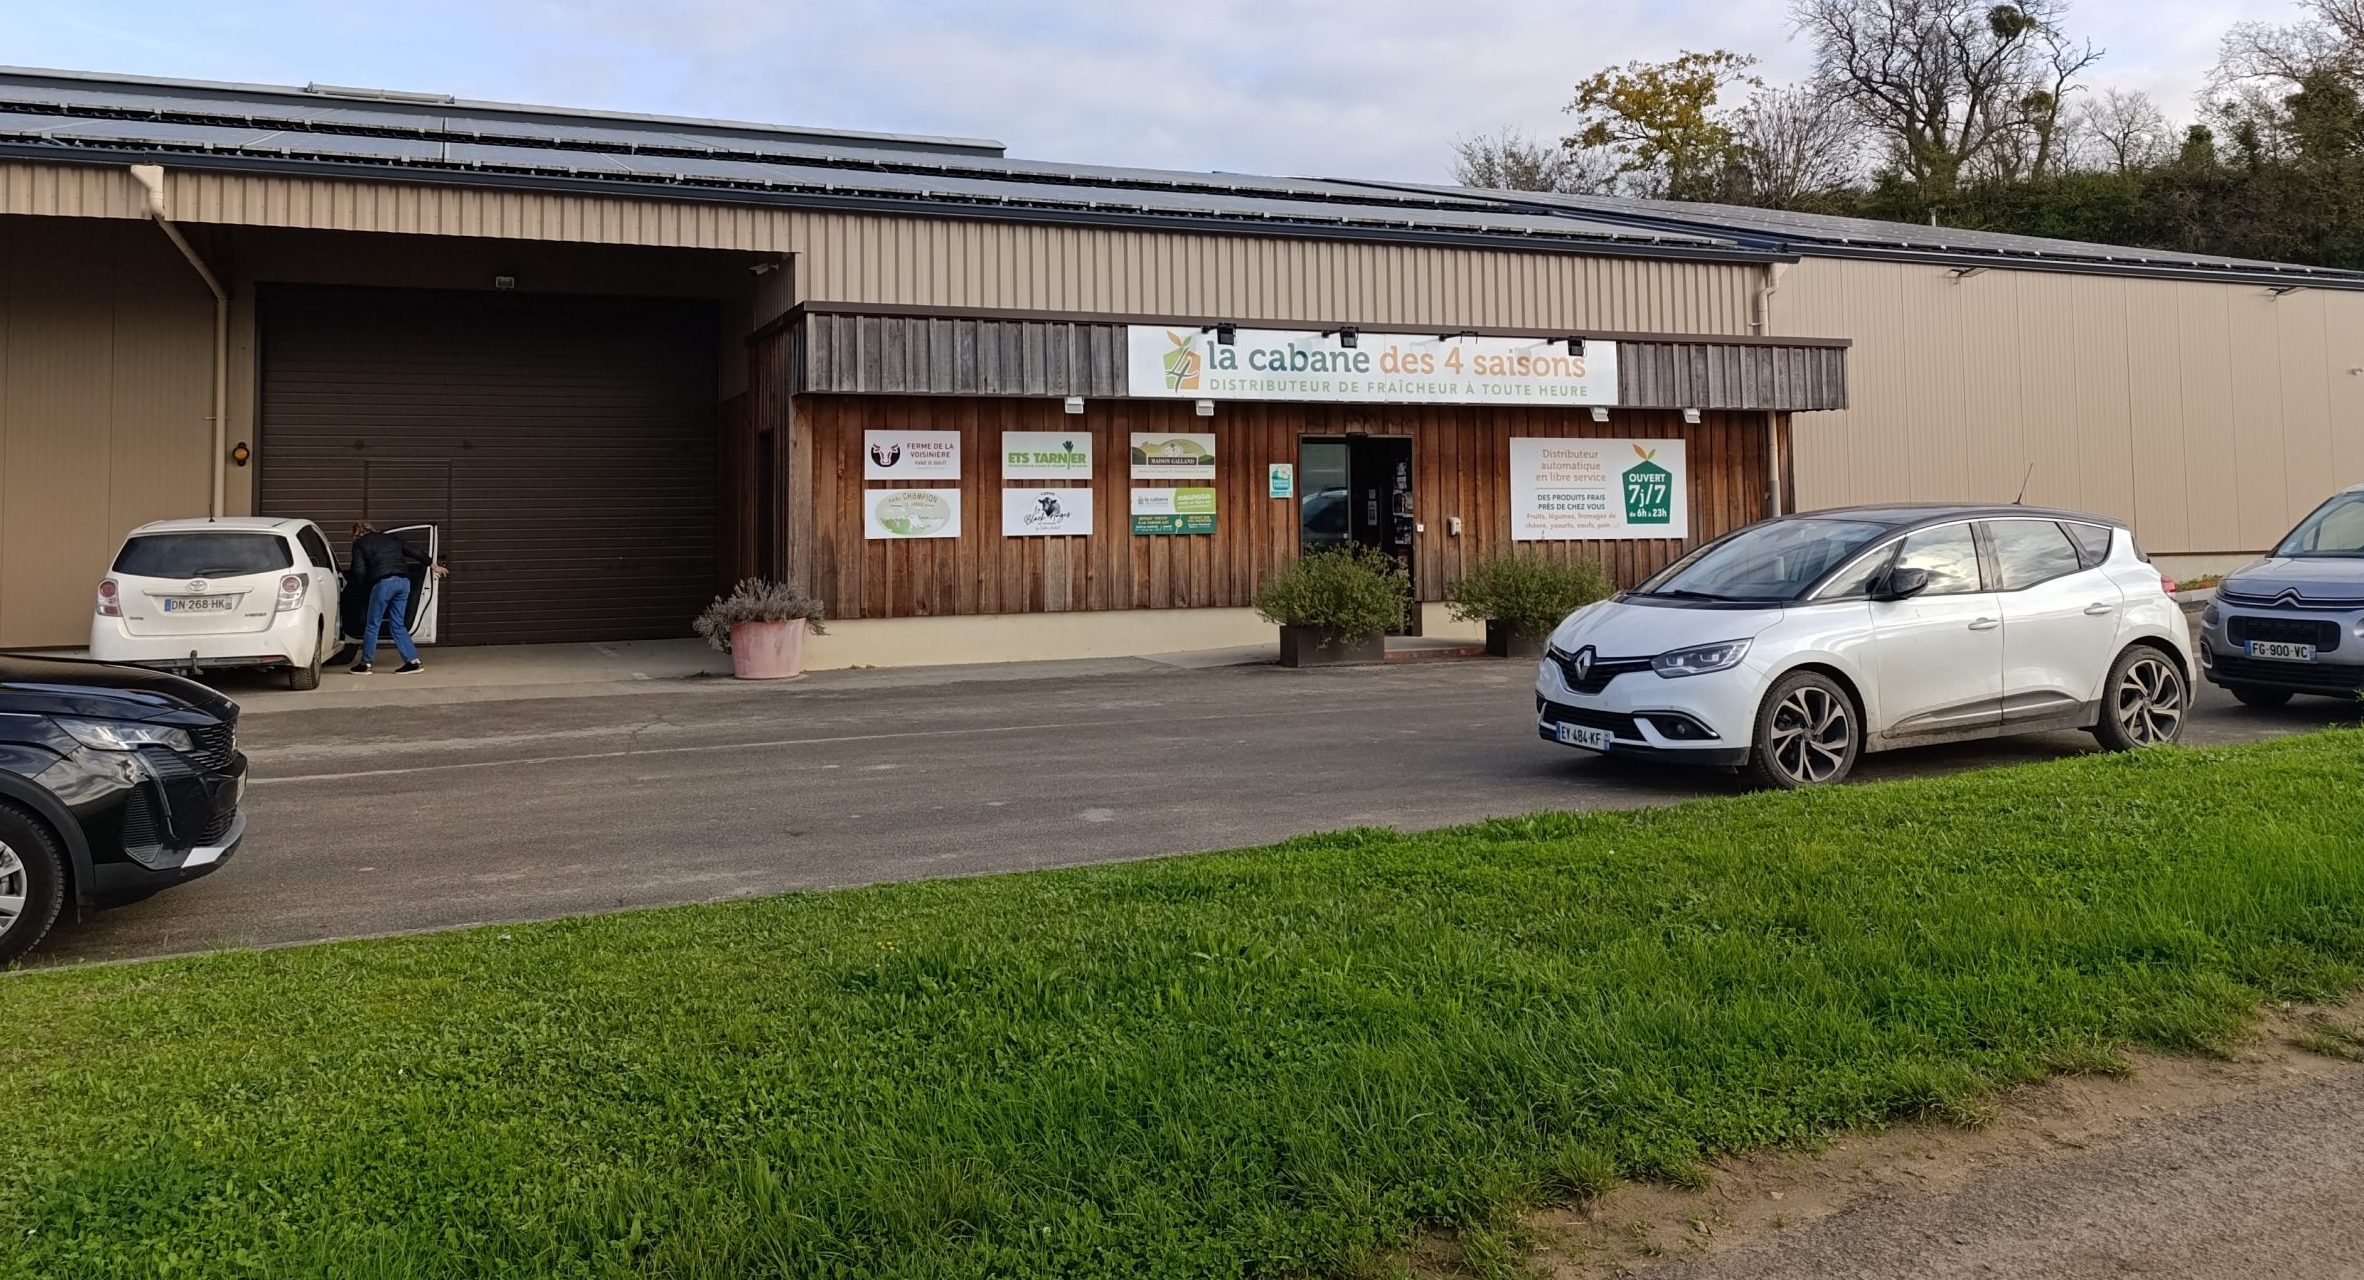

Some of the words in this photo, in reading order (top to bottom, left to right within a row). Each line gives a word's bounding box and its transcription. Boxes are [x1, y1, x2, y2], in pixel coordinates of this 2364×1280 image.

[1207, 340, 1238, 370] la
[1249, 342, 1370, 373] cabane
[1380, 345, 1435, 375] des
[1444, 346, 1464, 375] 4
[1473, 349, 1586, 378] saisons
[1210, 378, 1331, 393] DISTRIBUTEUR
[1339, 381, 1358, 393] DE
[1367, 379, 1457, 394] FRAÎCHEUR
[1465, 381, 1475, 394] À
[1482, 383, 1531, 396] TOUTE
[1539, 385, 1587, 397] HEURE
[1542, 449, 1598, 459] Distributeur
[1008, 452, 1029, 464] ETS
[1033, 452, 1086, 467] TARNIER
[1541, 462, 1601, 472] automatique
[1551, 472, 1571, 481] libre
[1573, 473, 1607, 481] service
[1628, 473, 1666, 482] OUVERT
[1628, 484, 1666, 507] 7j/7
[1538, 502, 1555, 510] PRÈS
[1578, 513, 1607, 521] fromages
[1637, 508, 1647, 517] 6h
[1652, 508, 1667, 517] 23h
[171, 599, 225, 610] DN-268-HK
[2252, 643, 2308, 658] FG-900-VC
